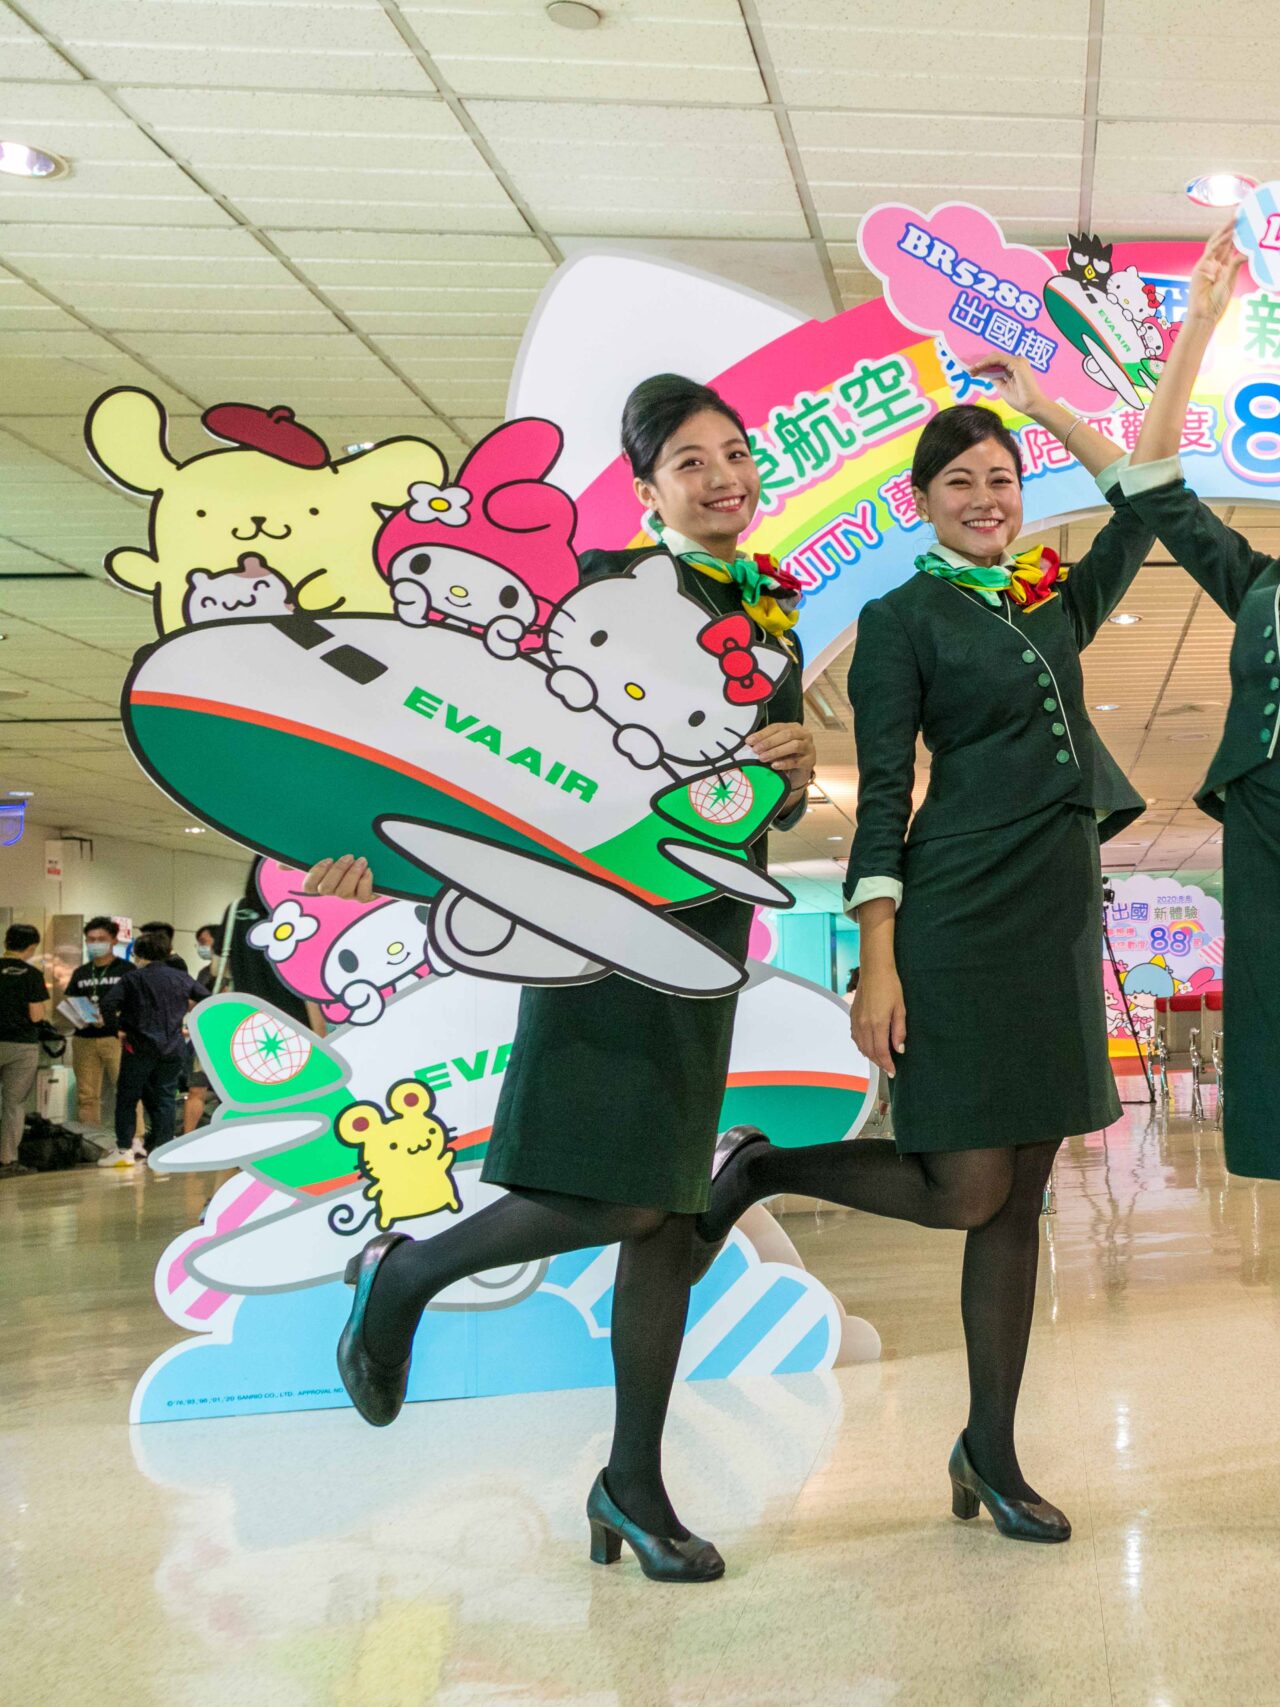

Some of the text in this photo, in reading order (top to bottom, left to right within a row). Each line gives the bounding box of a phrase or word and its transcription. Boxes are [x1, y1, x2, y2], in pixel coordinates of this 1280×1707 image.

[897, 222, 1043, 321] BR5288
[949, 291, 1058, 374] 出國趣
[1098, 308, 1115, 332] EVA
[402, 685, 599, 804] EVA AIR
[1150, 926, 1188, 954] 88
